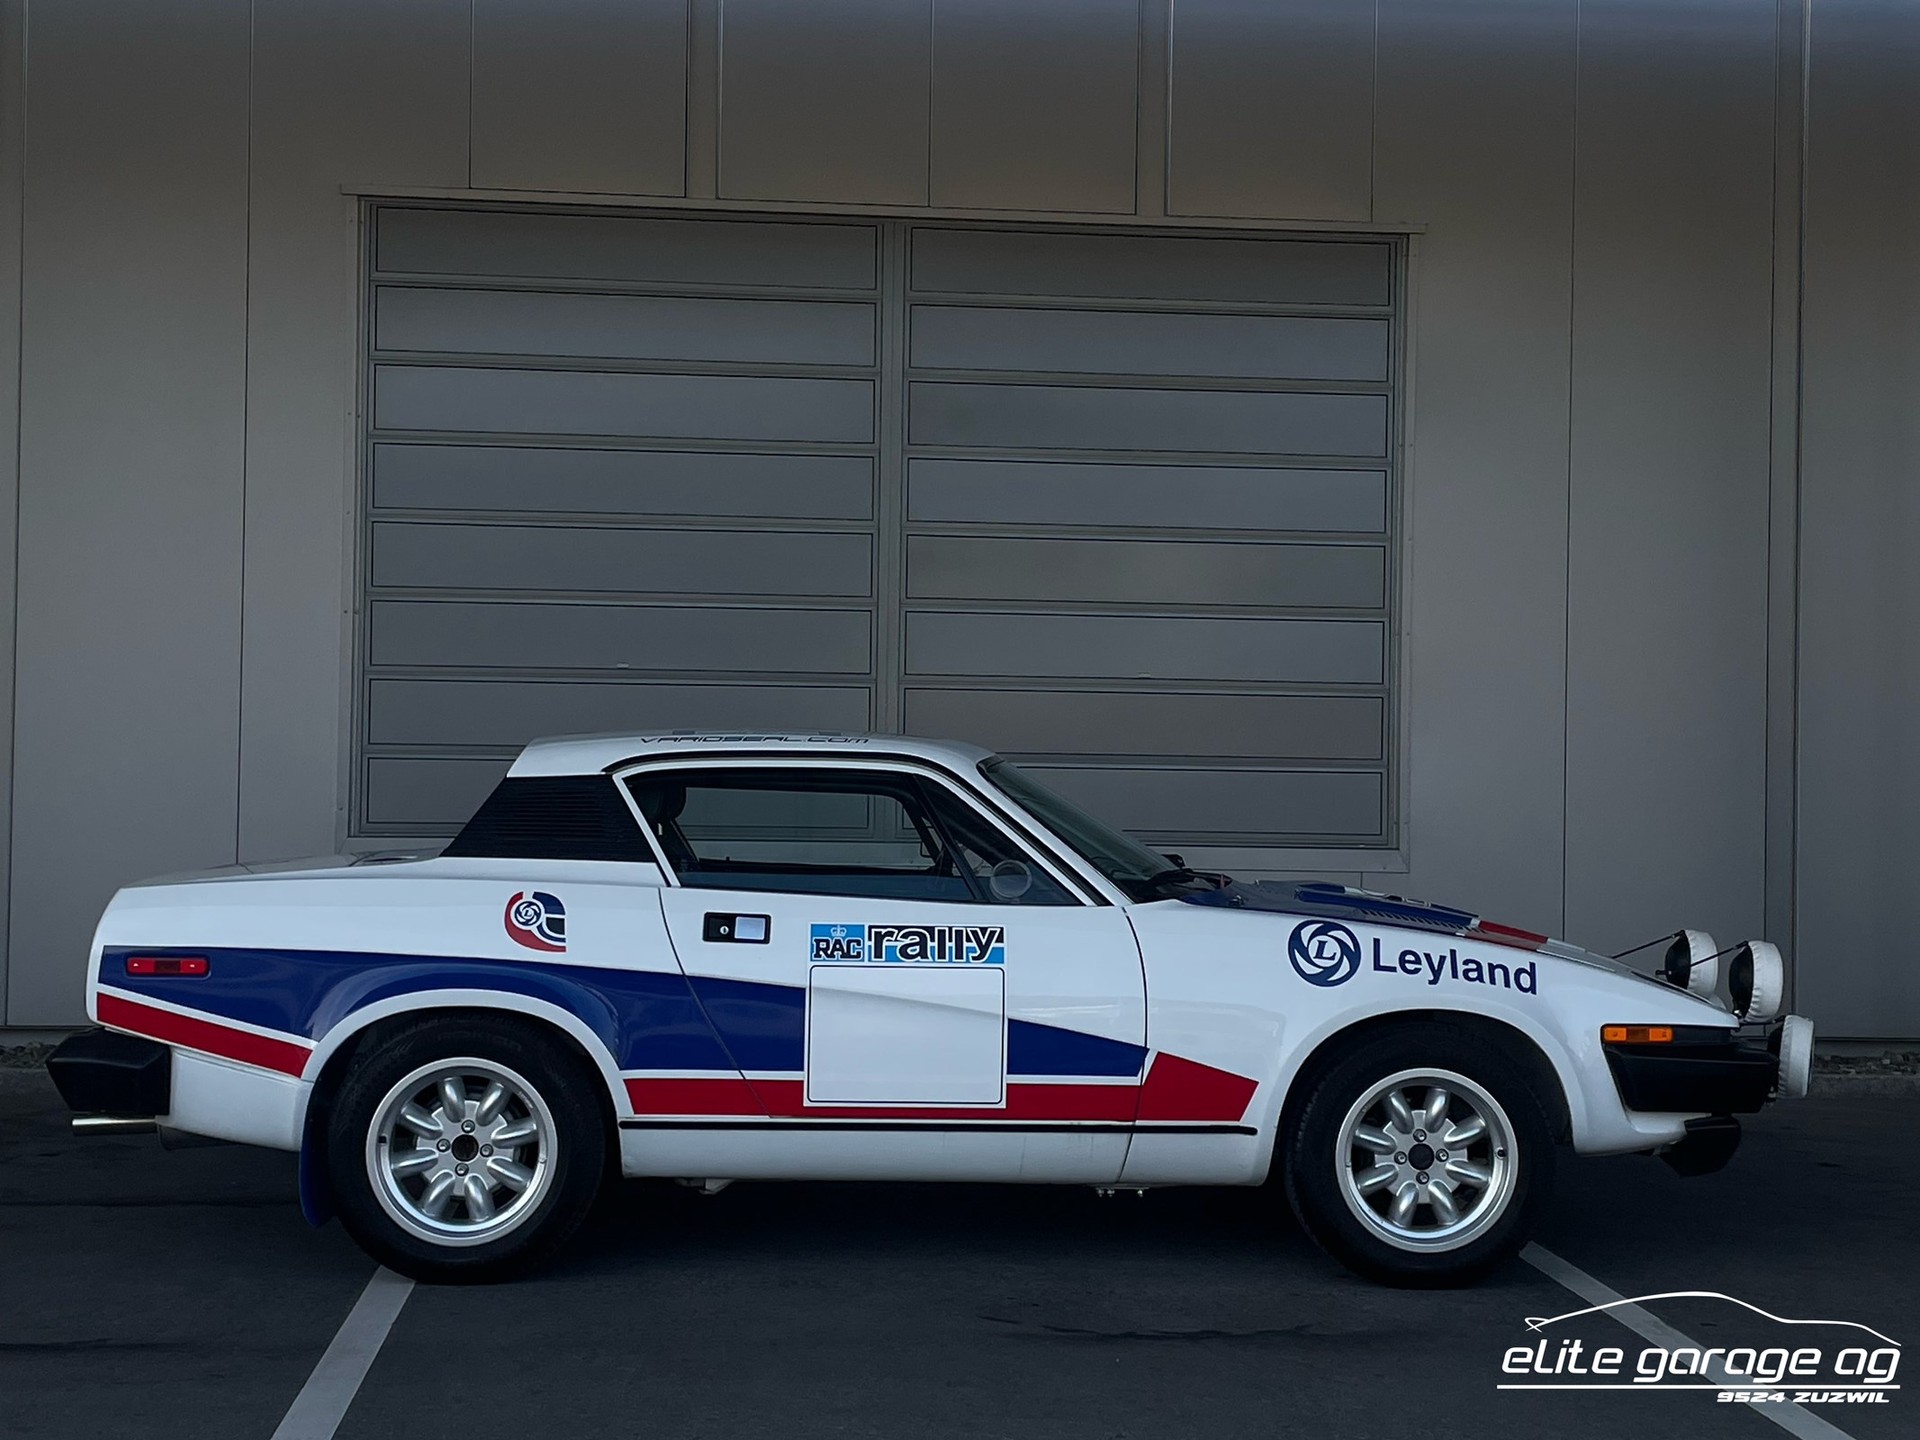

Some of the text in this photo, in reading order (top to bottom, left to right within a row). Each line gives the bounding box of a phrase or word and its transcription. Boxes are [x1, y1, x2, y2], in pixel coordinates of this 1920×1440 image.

[813, 926, 1000, 963] RAC rally
[1372, 937, 1537, 995] Leyland
